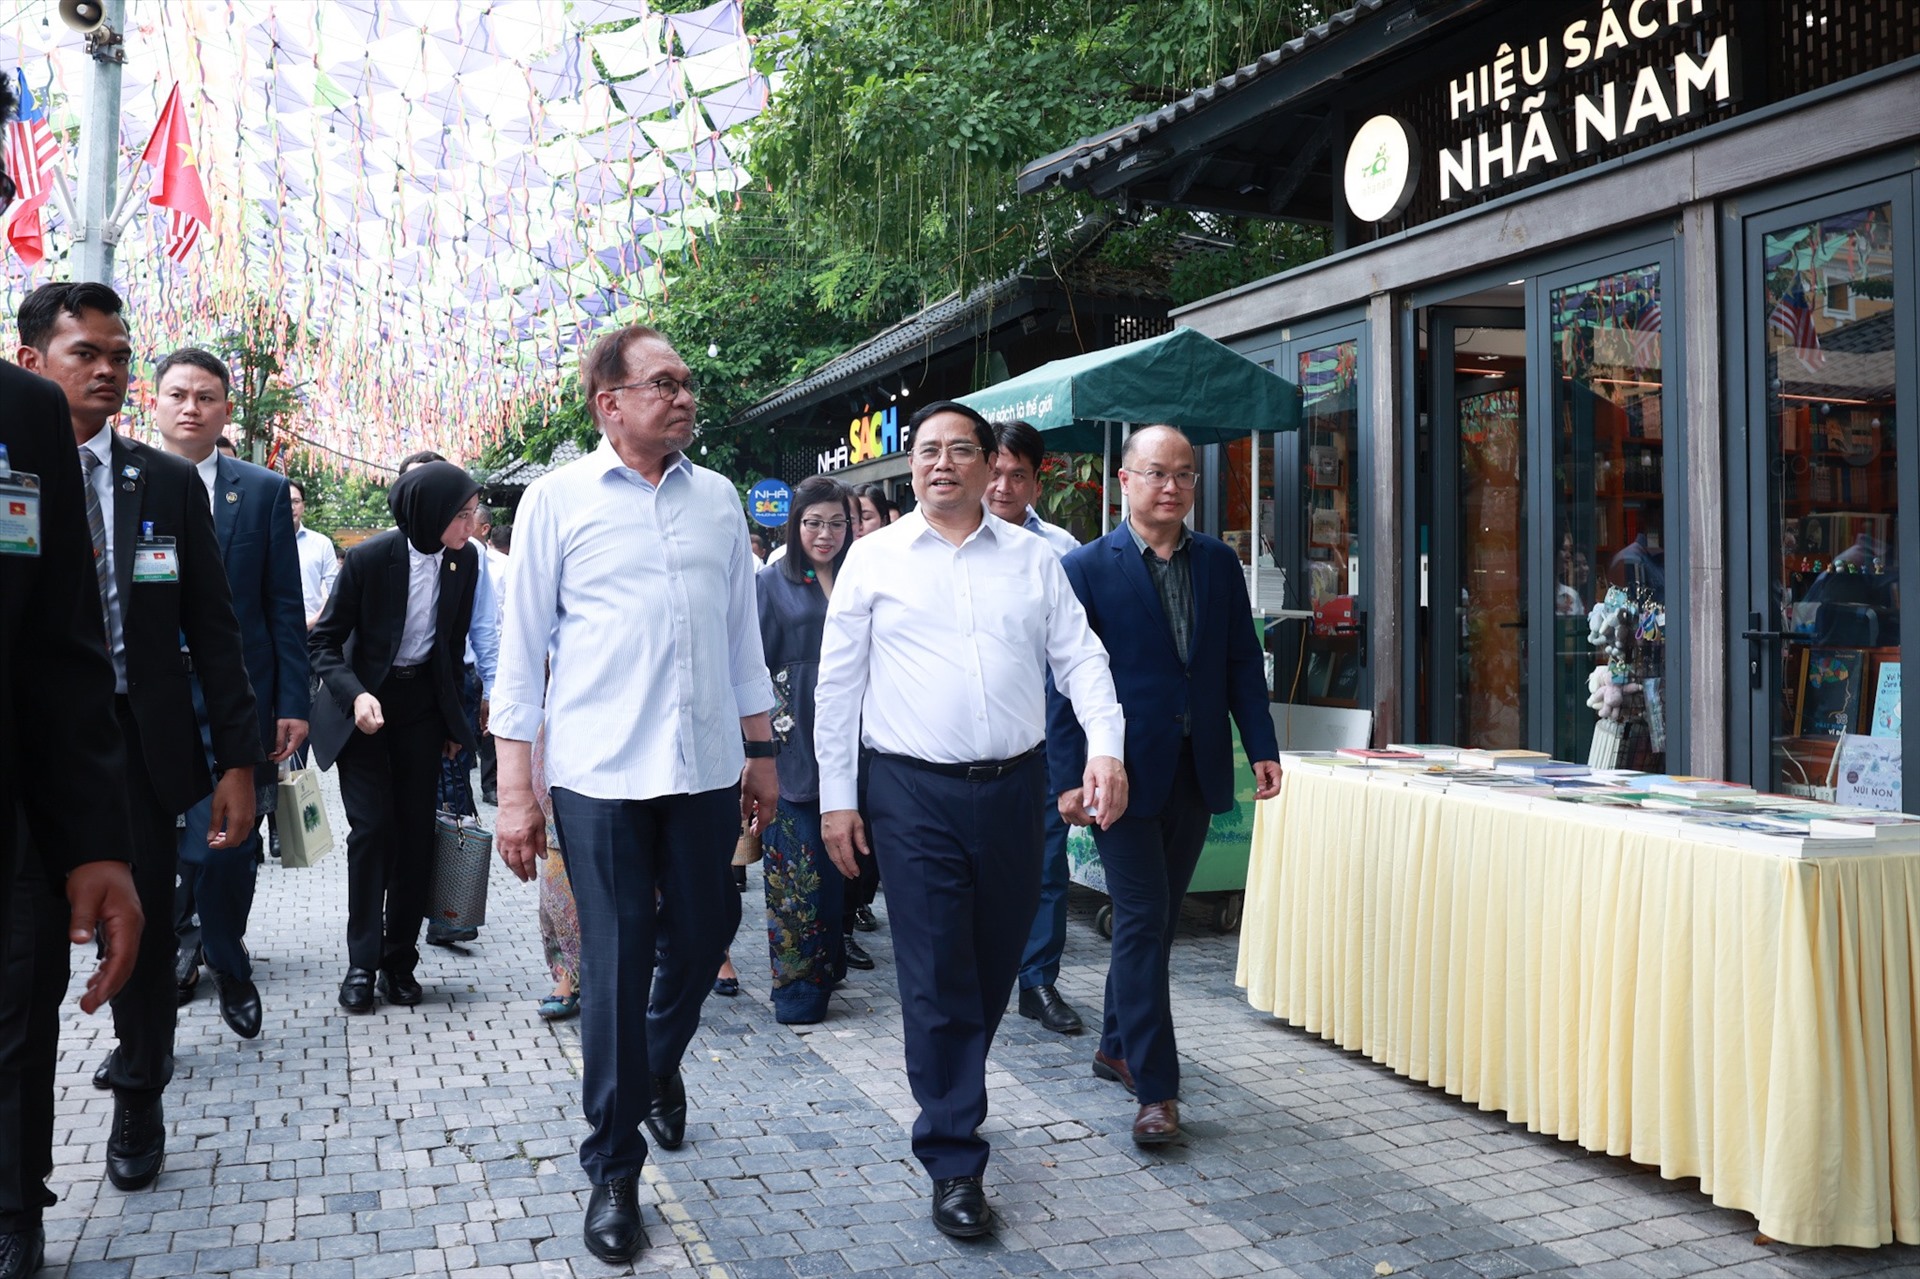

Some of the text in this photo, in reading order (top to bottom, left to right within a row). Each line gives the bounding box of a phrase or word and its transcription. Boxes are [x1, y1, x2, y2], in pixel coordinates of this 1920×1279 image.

[1450, 36, 1549, 121] HIỆU
[1438, 34, 1731, 201] NHÃ NAM
[996, 404, 1015, 422] sách
[1016, 401, 1025, 420] là
[1025, 394, 1039, 417] thế
[1038, 393, 1054, 419] giới
[817, 437, 848, 475] NHÀ
[849, 403, 897, 465] SÁCH
[754, 487, 789, 499] NHÀ
[755, 499, 789, 513] SÁCH
[1834, 713, 1849, 725] 18
[1853, 784, 1893, 798] NÚI NON
